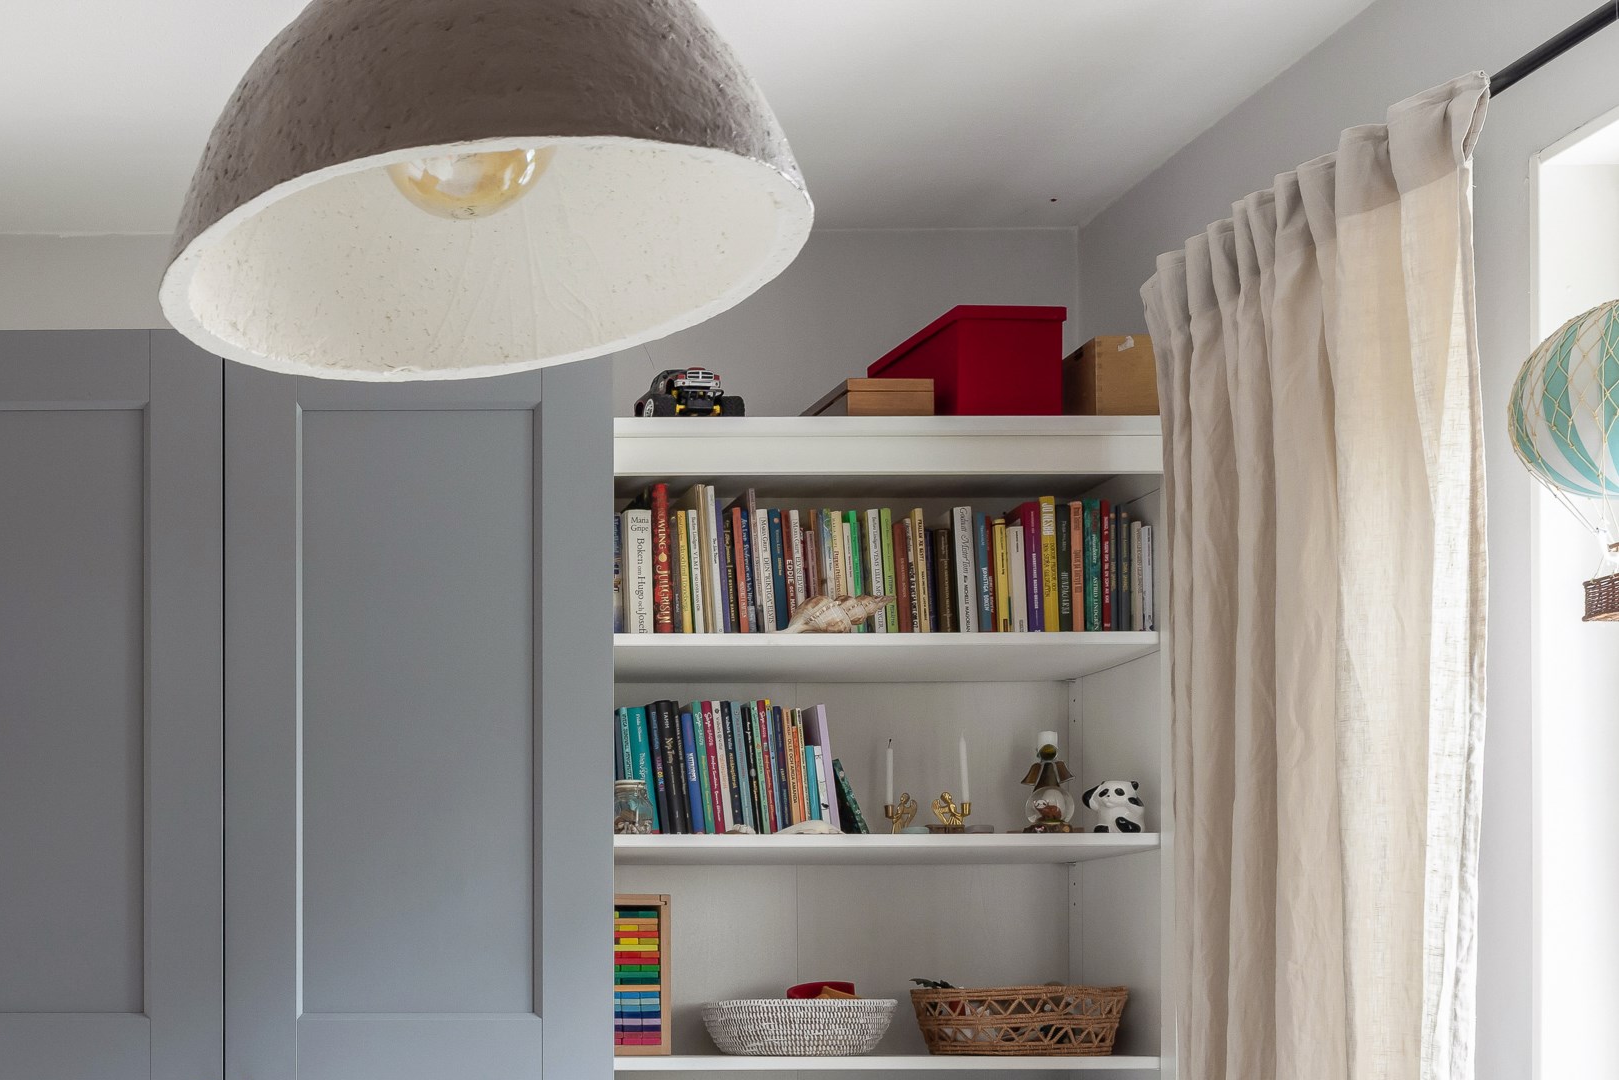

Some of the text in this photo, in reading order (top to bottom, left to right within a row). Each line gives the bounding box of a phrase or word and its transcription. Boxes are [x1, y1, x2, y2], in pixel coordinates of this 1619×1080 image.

[636, 538, 645, 564] Boken
[786, 559, 794, 584] EDDIE
[635, 576, 646, 599] Hugo
[637, 611, 646, 634] Josefi
